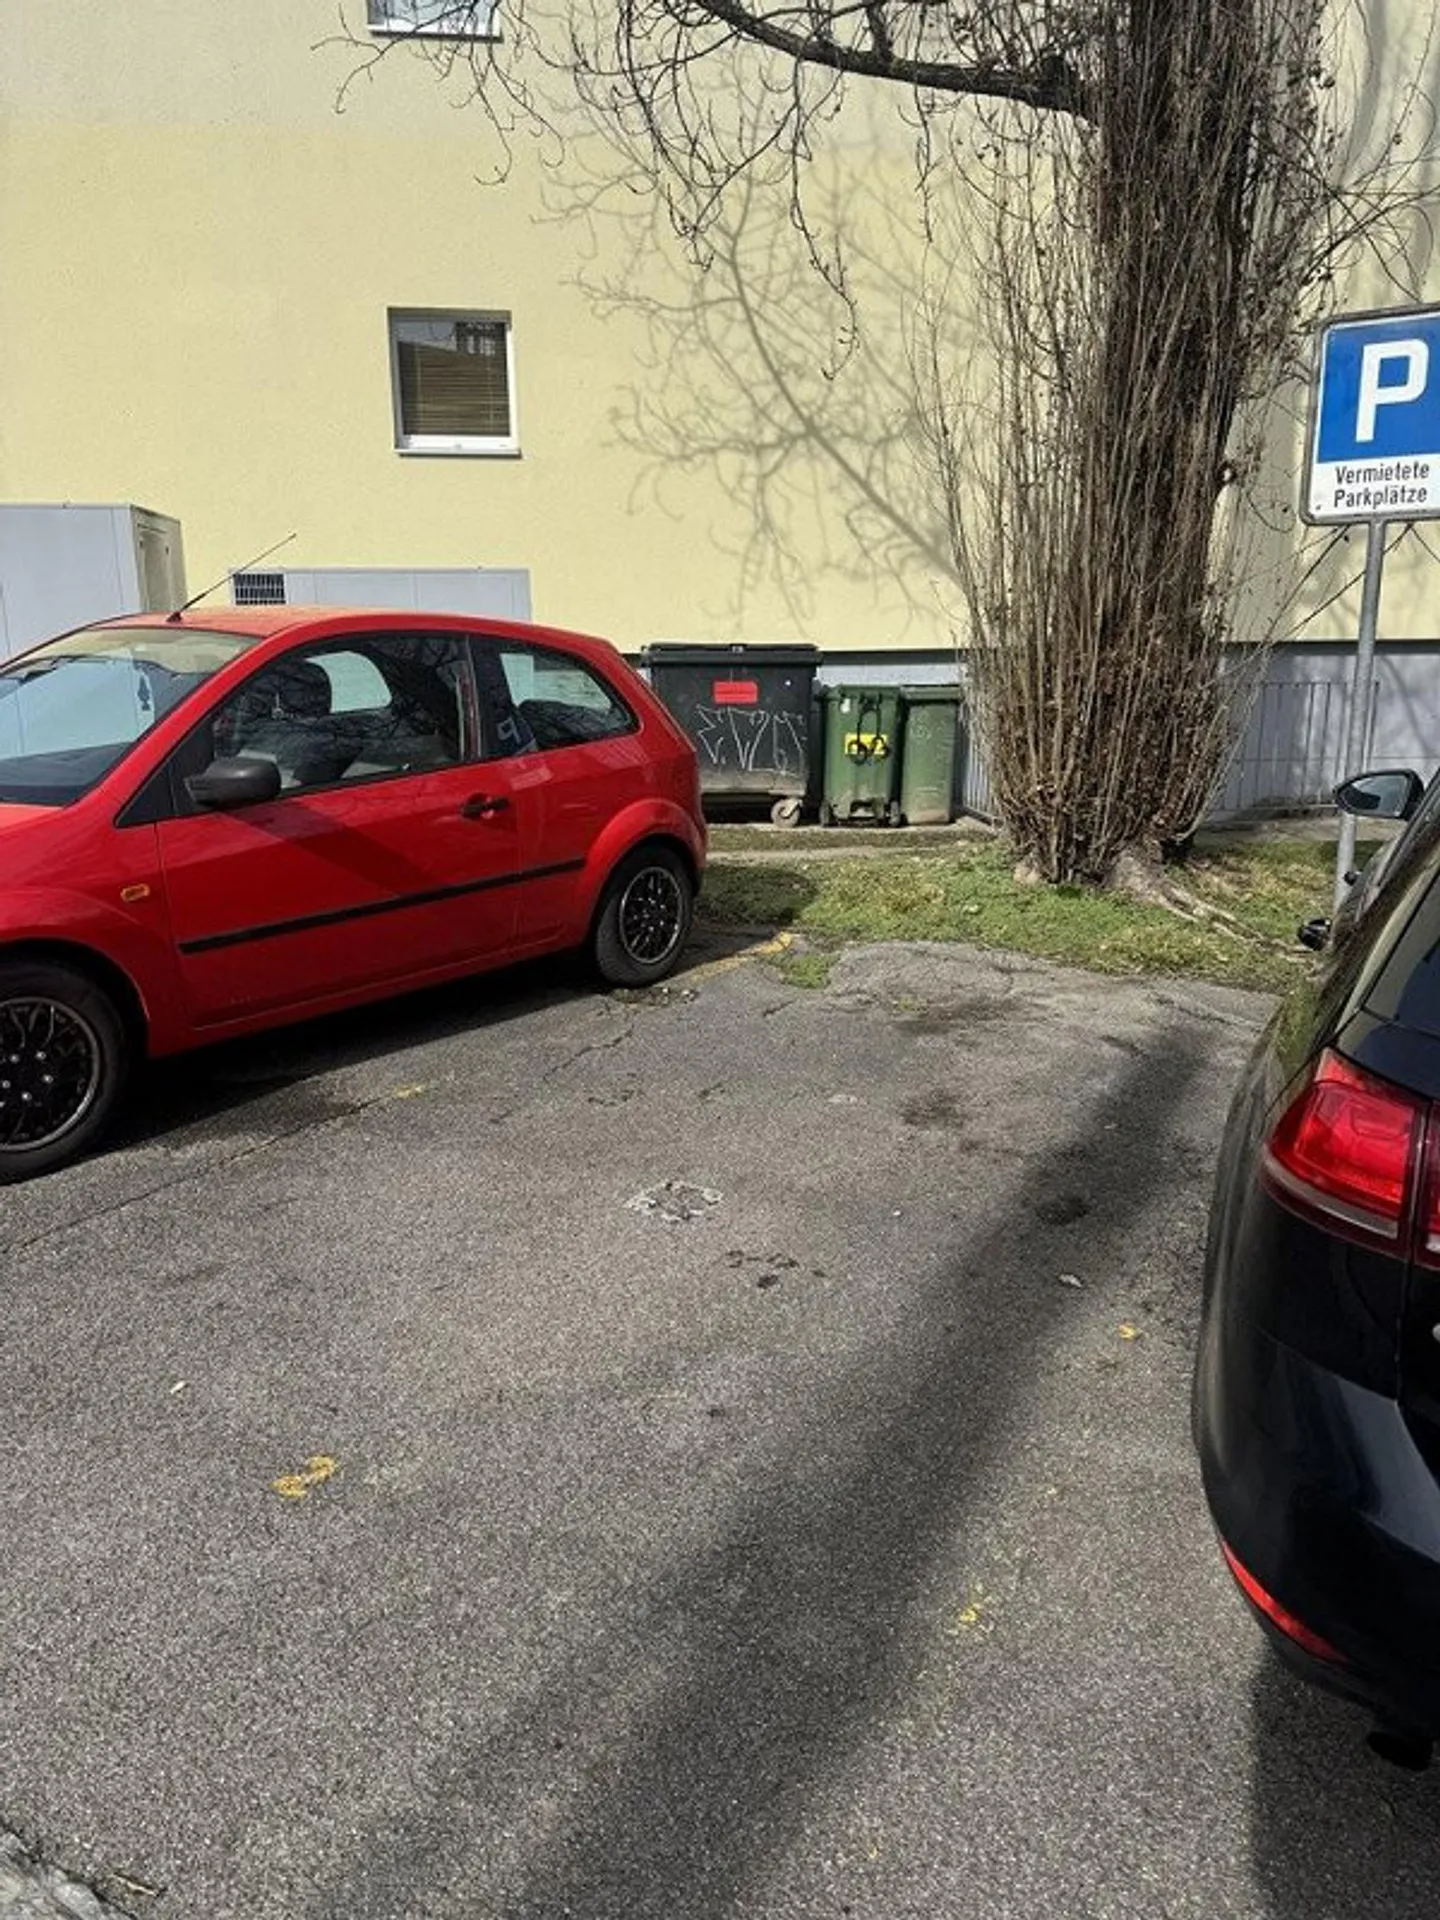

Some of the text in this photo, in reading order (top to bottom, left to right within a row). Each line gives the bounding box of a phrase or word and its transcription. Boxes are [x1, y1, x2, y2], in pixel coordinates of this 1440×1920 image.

[1355, 338, 1430, 443] P
[1335, 461, 1430, 485] Vermietete
[1333, 485, 1428, 510] Parkplätze
